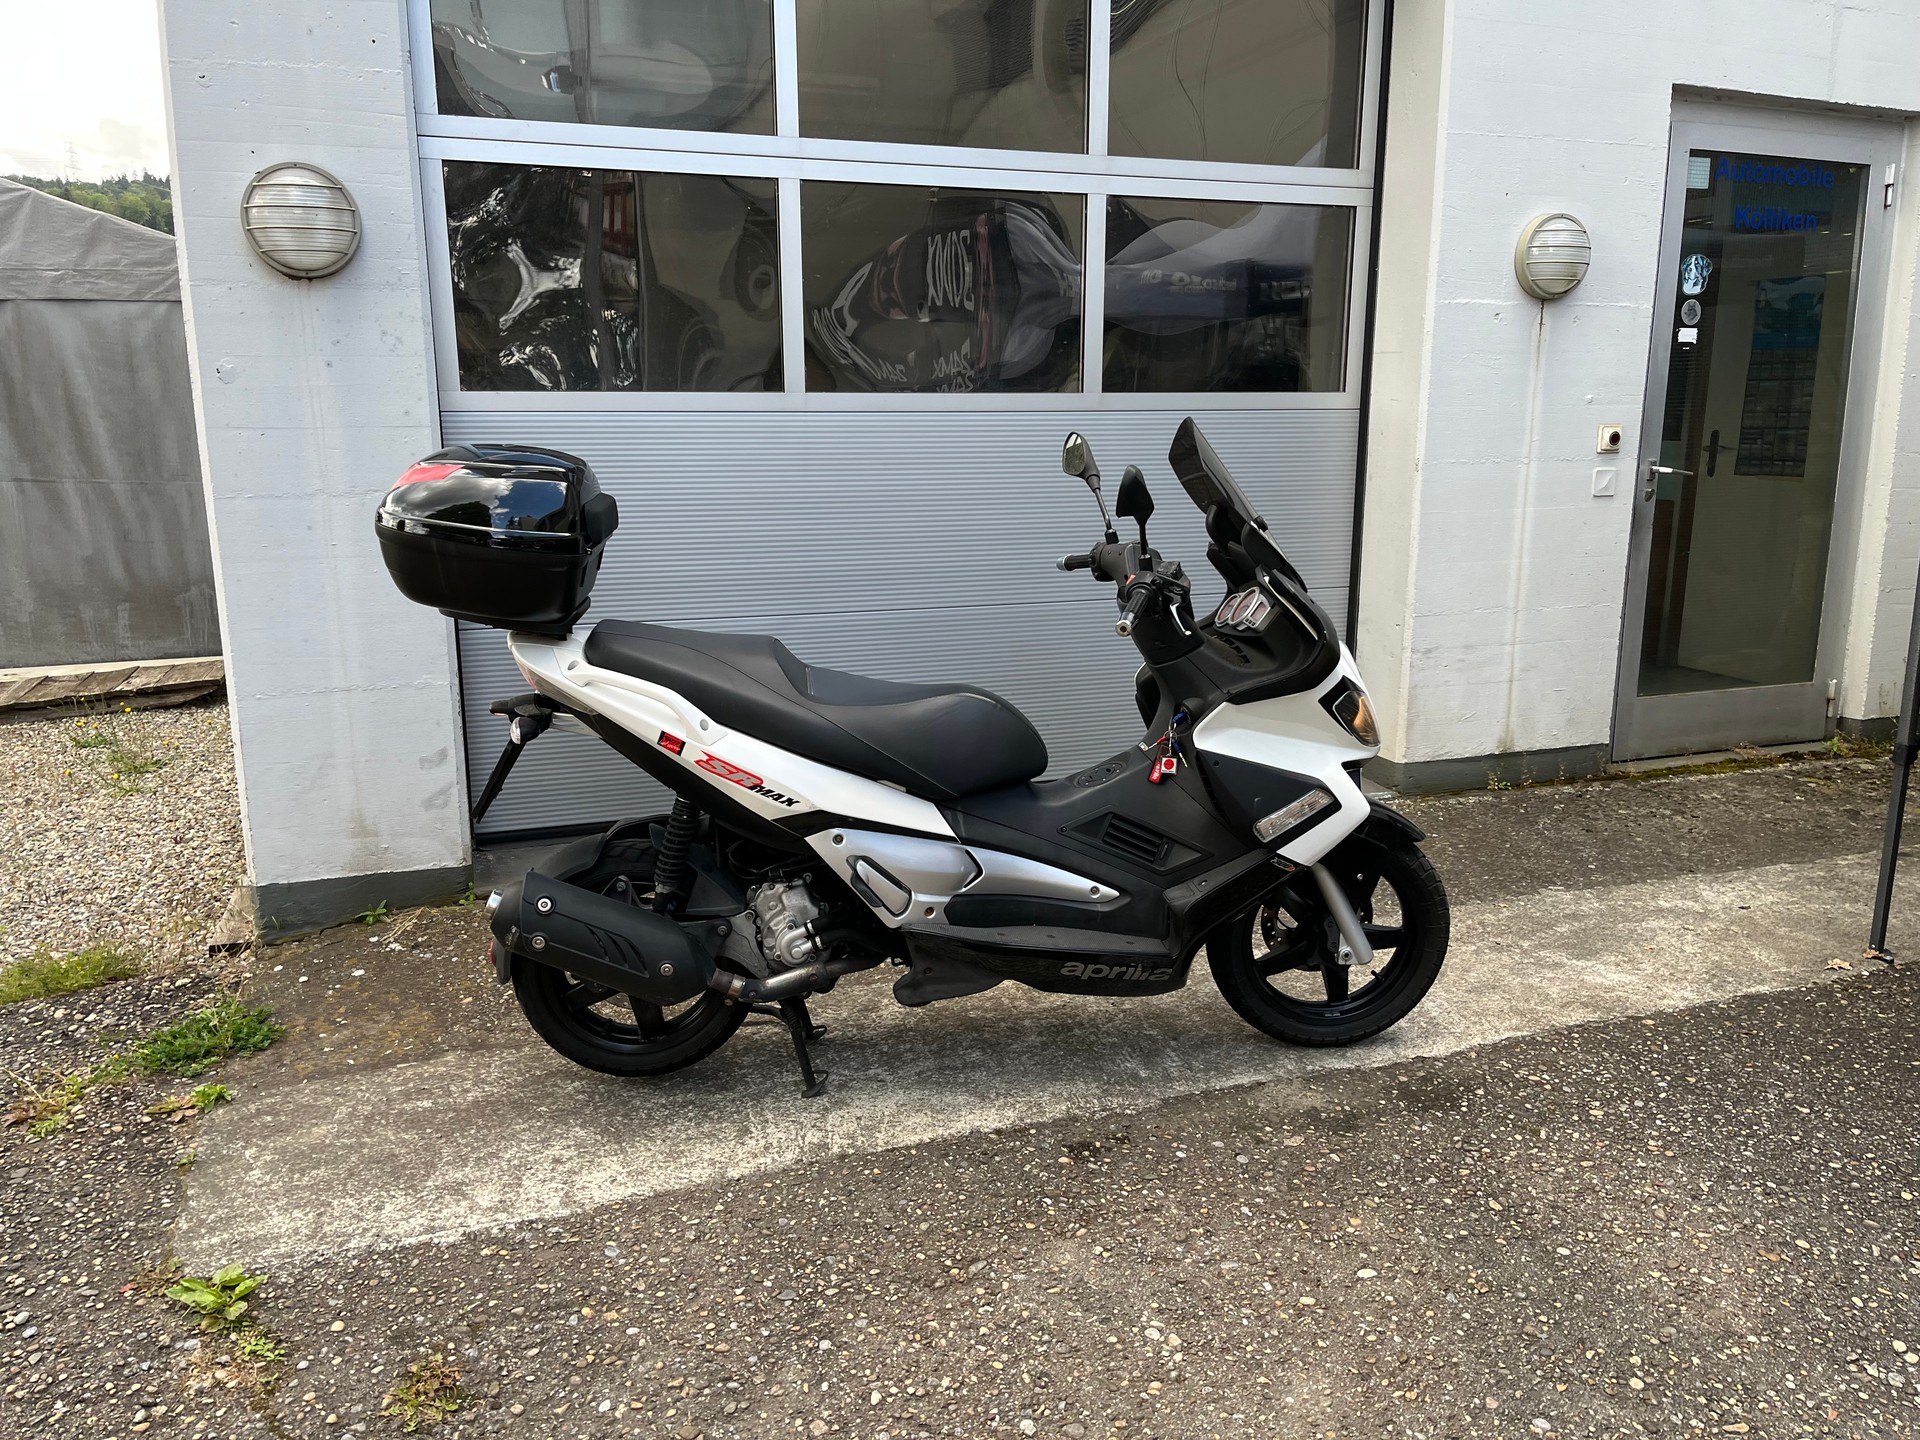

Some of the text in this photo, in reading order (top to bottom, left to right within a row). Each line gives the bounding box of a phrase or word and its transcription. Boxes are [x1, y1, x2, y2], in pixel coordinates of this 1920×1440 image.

[1716, 158, 1835, 188] Automobile
[1736, 205, 1818, 232] Kölliken
[694, 750, 801, 807] SR MAX
[1059, 961, 1173, 981] aprilia
